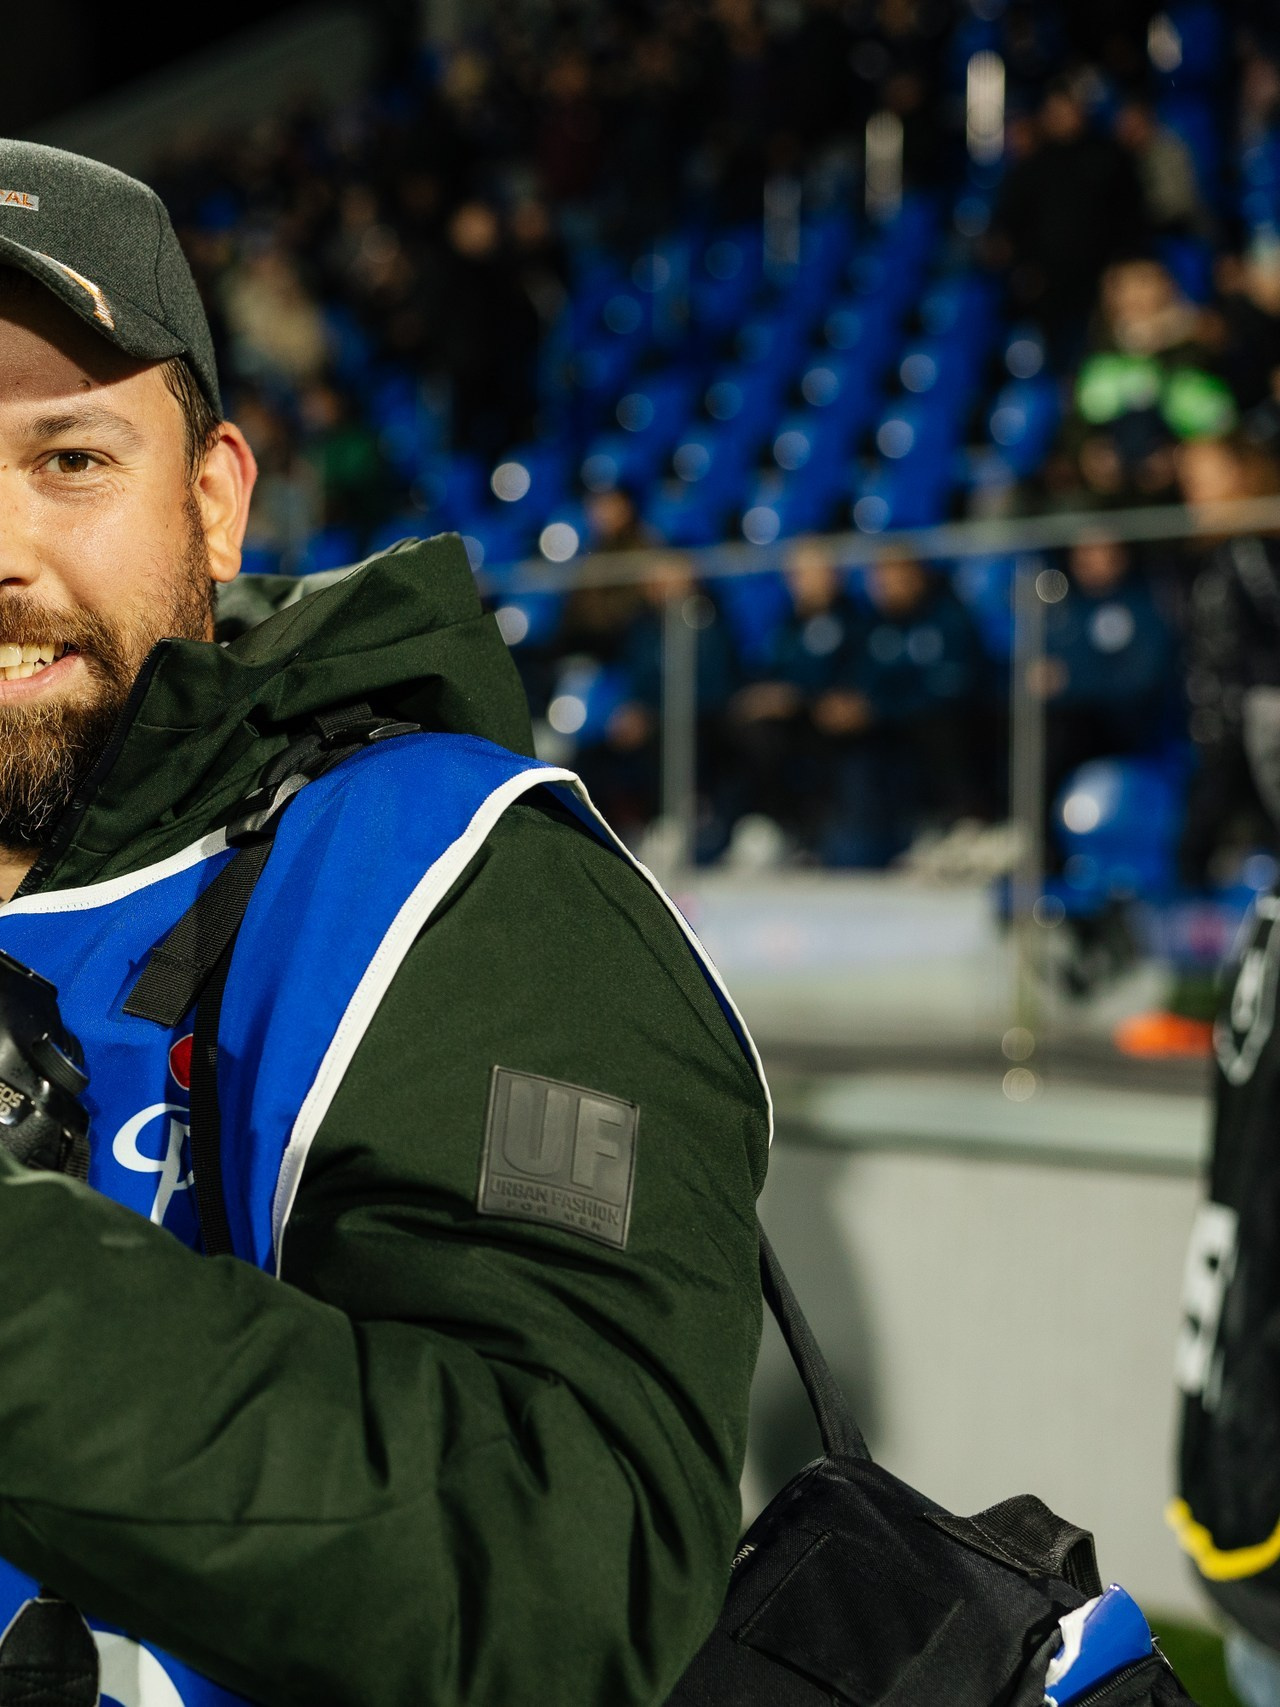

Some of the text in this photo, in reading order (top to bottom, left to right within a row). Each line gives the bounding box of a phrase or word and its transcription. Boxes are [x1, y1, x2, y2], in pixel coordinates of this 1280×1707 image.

[502, 1078, 626, 1190] UF
[490, 1178, 620, 1226] URBAN FASHION
